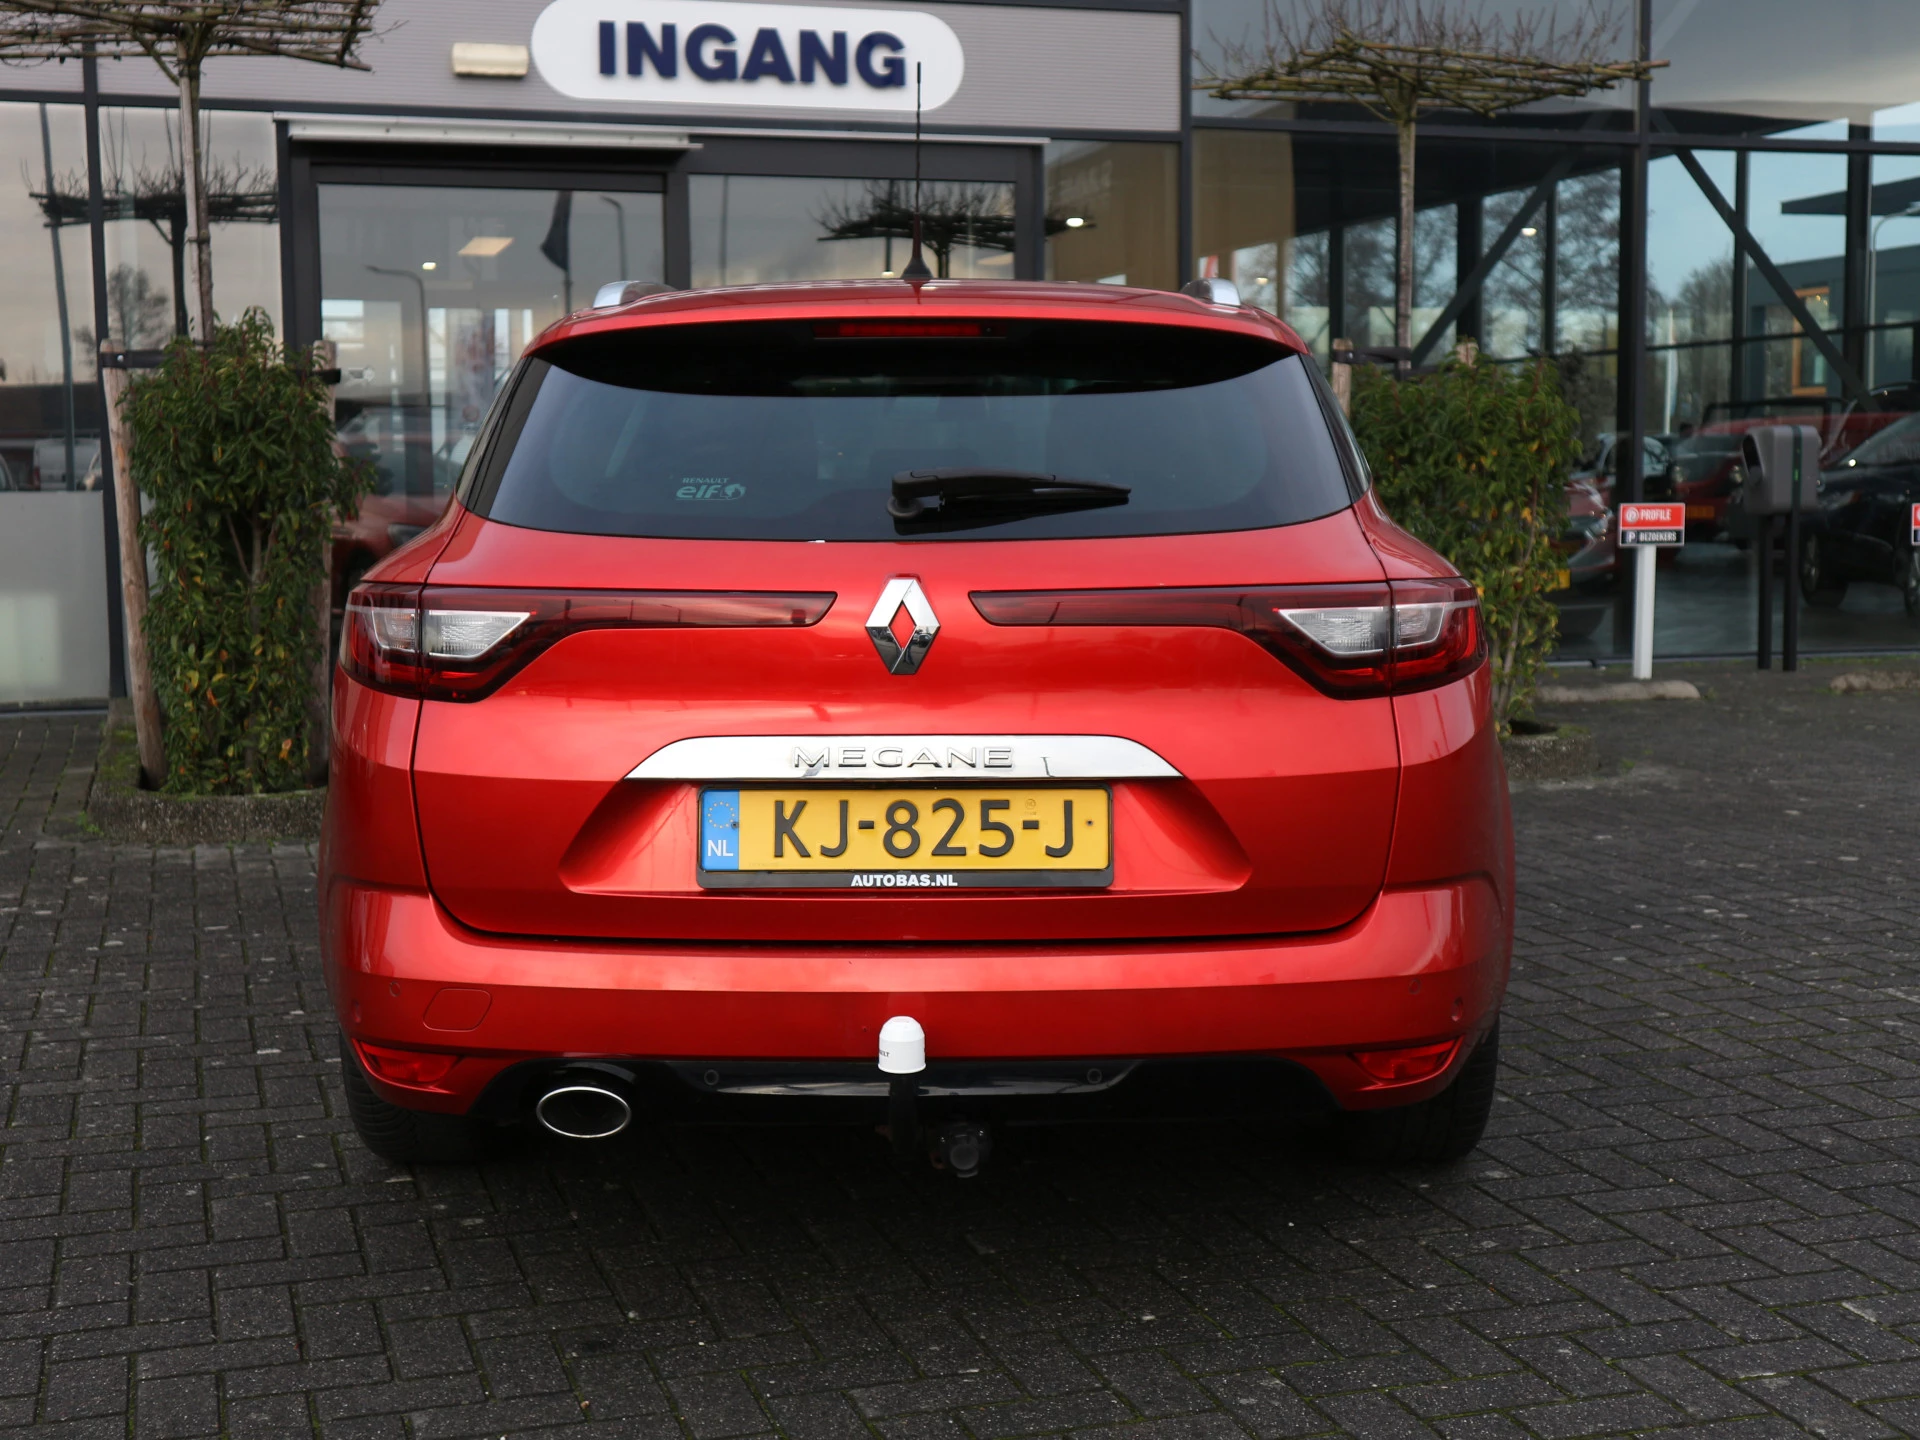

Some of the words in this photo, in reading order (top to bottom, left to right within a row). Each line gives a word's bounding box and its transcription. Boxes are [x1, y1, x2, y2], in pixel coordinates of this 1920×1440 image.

[598, 20, 906, 88] INGANG
[676, 485, 721, 498] elf
[1640, 508, 1671, 520] PROFILE
[1639, 532, 1677, 542] BEZOEKERS
[793, 746, 1014, 768] MEGANE
[773, 798, 1074, 859] KJ-825-J
[707, 839, 734, 857] NL
[851, 874, 958, 887] AUTOBAS.NL
